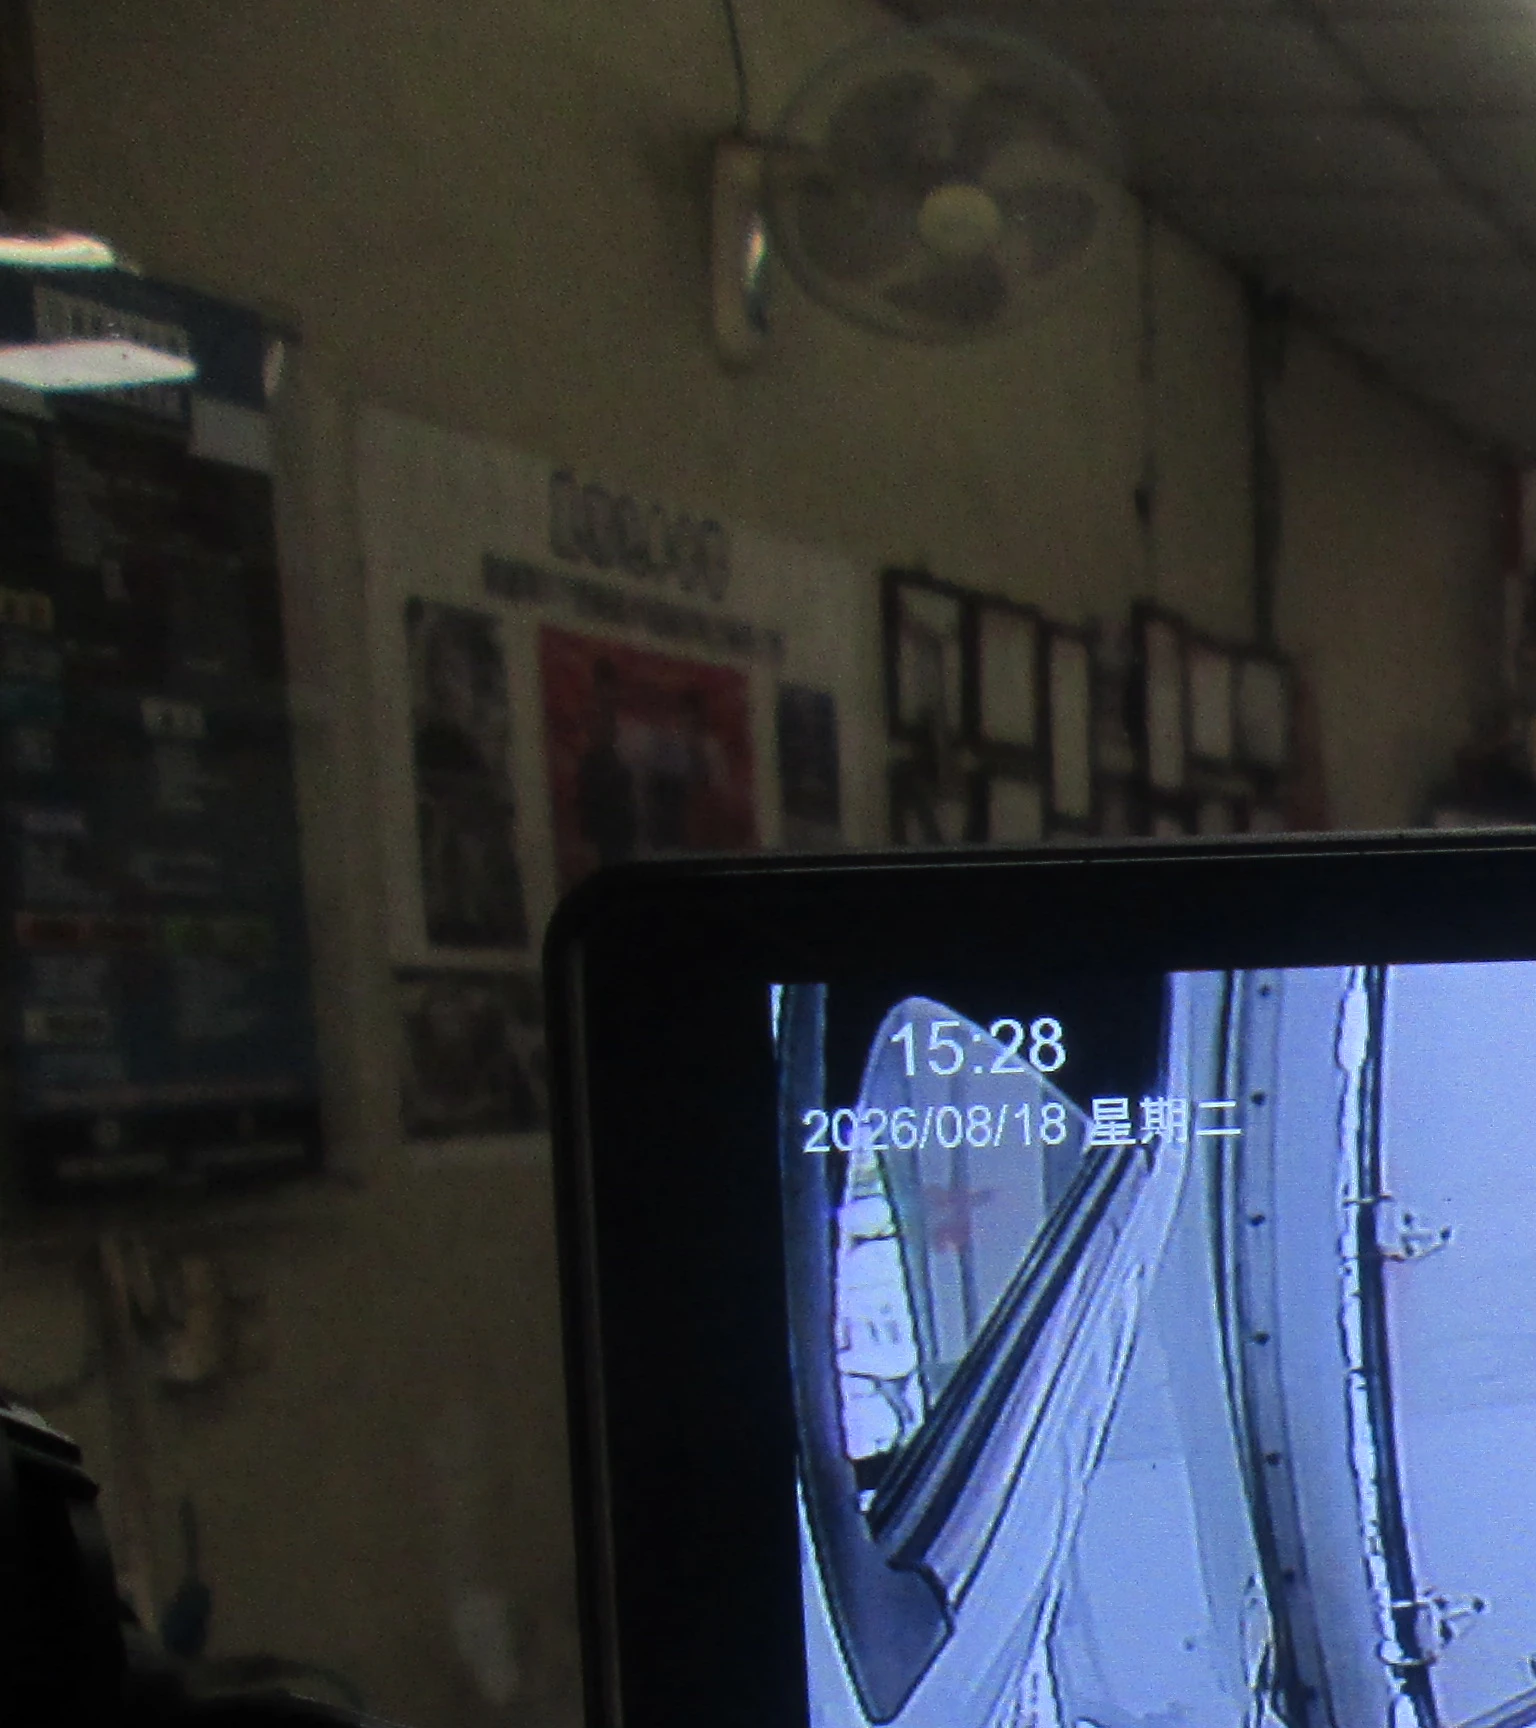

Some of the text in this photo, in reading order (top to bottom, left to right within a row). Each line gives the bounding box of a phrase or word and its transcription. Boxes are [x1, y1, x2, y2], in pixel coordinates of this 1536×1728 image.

[890, 1017, 1067, 1077] 15:28
[801, 1096, 1243, 1154] 2026/08/18 星期二
